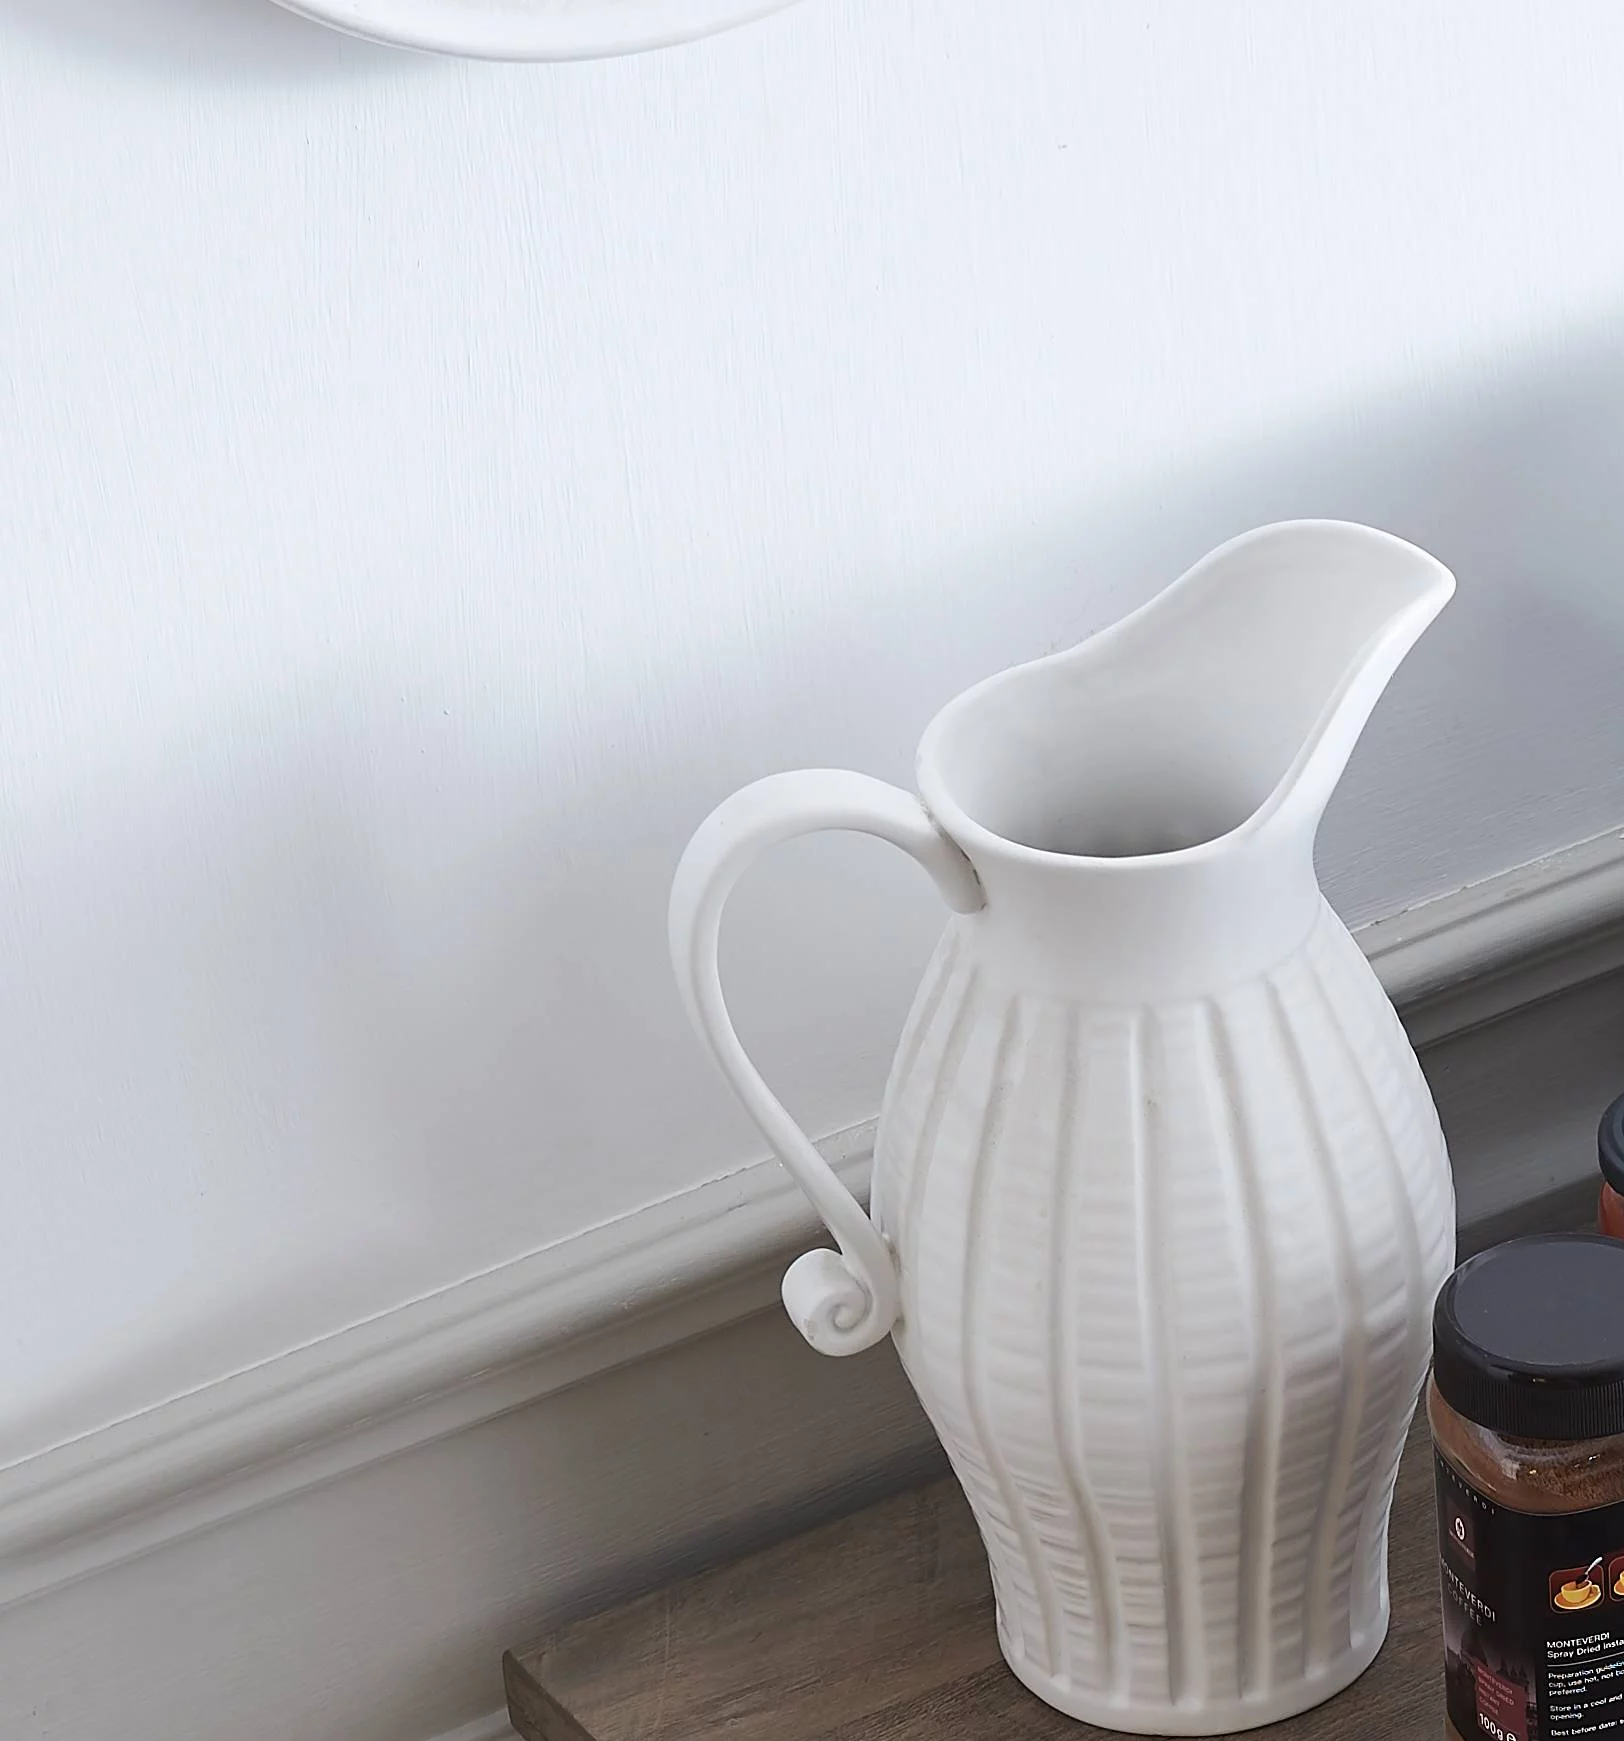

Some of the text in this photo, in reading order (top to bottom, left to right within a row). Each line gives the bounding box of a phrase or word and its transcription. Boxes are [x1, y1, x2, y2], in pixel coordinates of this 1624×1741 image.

[1448, 1584, 1482, 1627] COFFEE
[1547, 1632, 1610, 1649] MONTEVERDI
[1547, 1649, 1574, 1659] Spray
[1576, 1645, 1601, 1656] Dried
[1548, 1669, 1594, 1680] Preparation
[1584, 1676, 1599, 1684] hot,
[1601, 1671, 1614, 1679] not
[1549, 1686, 1587, 1696] preferred.
[1590, 1698, 1607, 1708] cool
[1608, 1693, 1623, 1703] and
[1550, 1711, 1584, 1721] opening.
[1479, 1712, 1503, 1741] 100g
[1551, 1729, 1570, 1737] Best
[1571, 1724, 1597, 1735] before
[1599, 1720, 1618, 1730] date:
